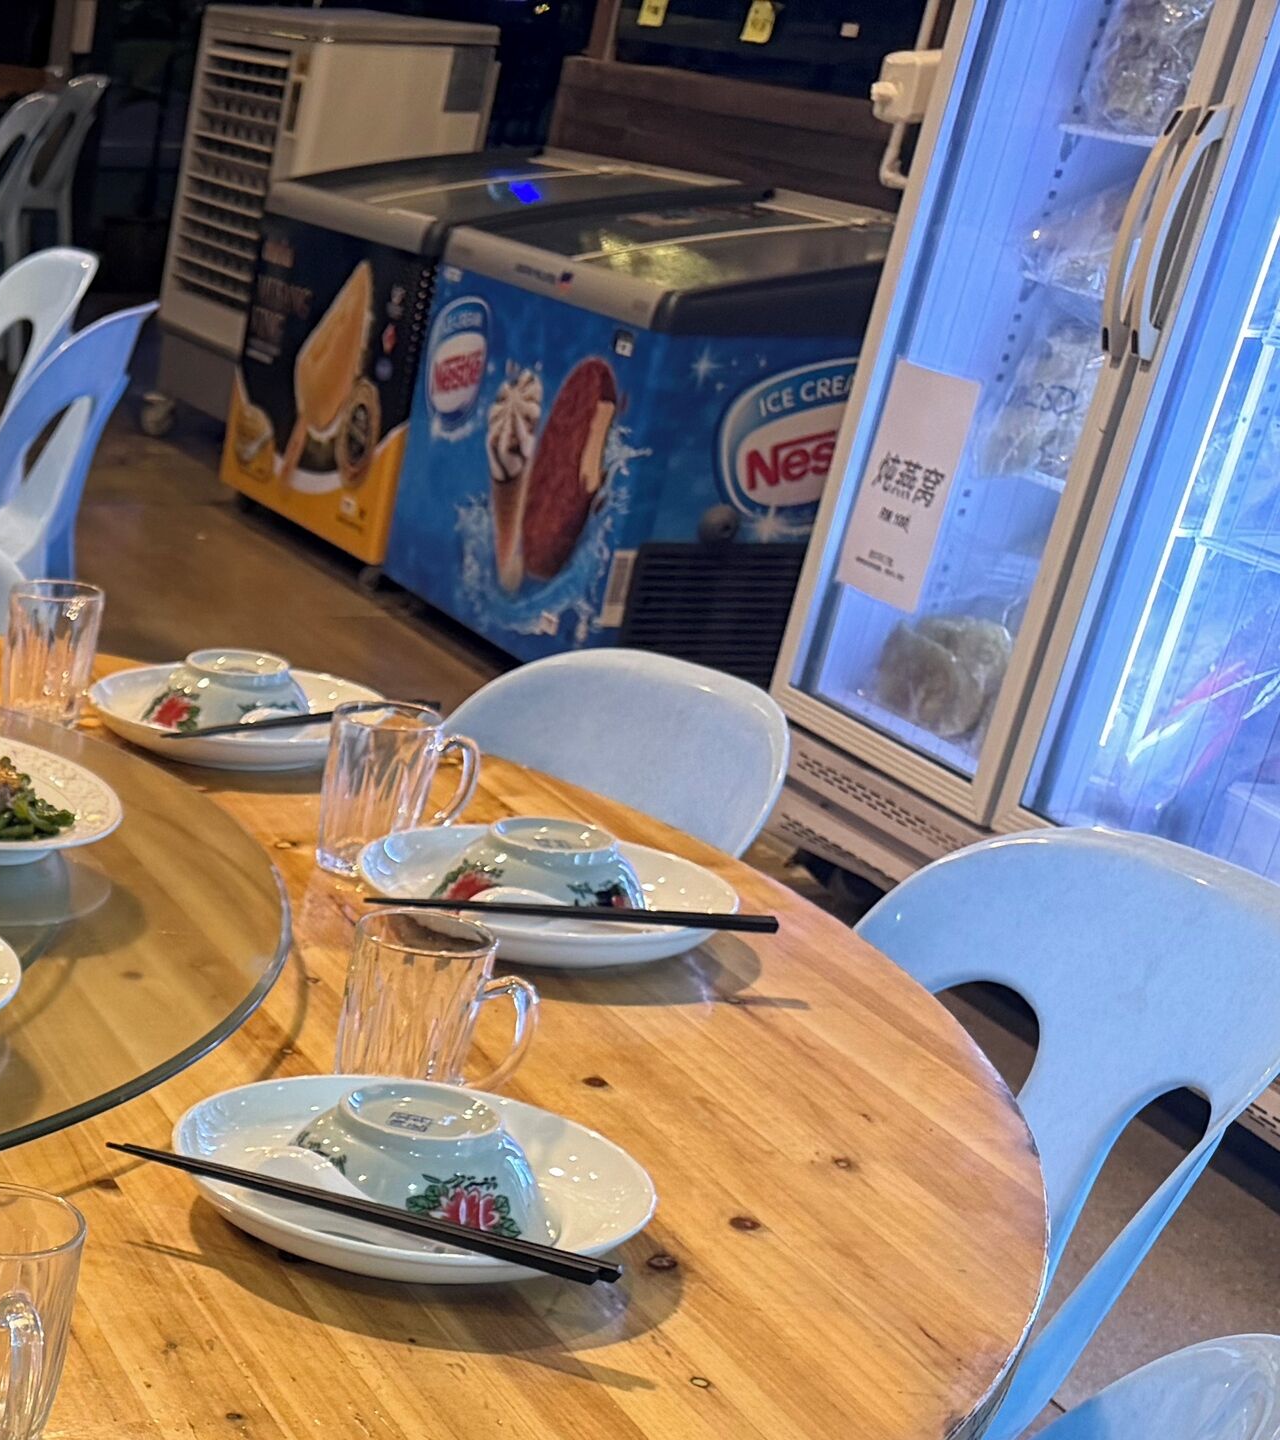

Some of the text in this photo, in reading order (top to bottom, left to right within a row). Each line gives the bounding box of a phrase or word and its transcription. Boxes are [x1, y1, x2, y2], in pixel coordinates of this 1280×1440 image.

[759, 374, 854, 417] ICE CRE
[746, 430, 837, 491] Nes
